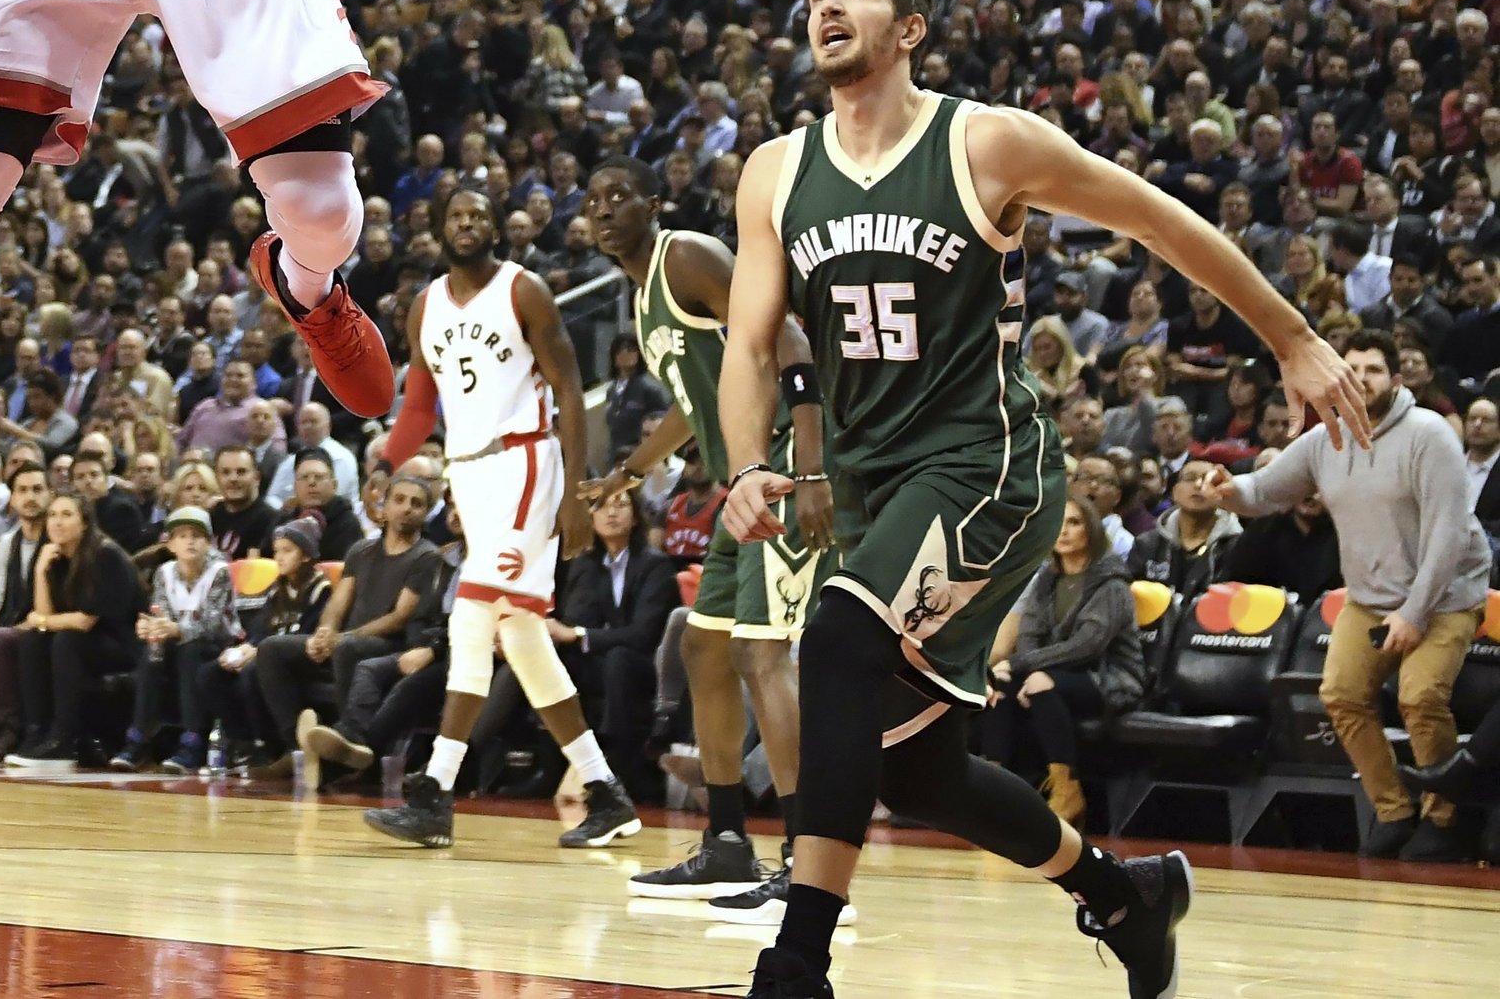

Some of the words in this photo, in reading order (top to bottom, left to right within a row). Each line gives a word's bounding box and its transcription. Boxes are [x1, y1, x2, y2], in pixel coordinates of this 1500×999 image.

[790, 213, 969, 281] MILWAUKEE
[830, 282, 920, 362] 35
[459, 356, 477, 394] 5
[1190, 632, 1272, 649] mastercard
